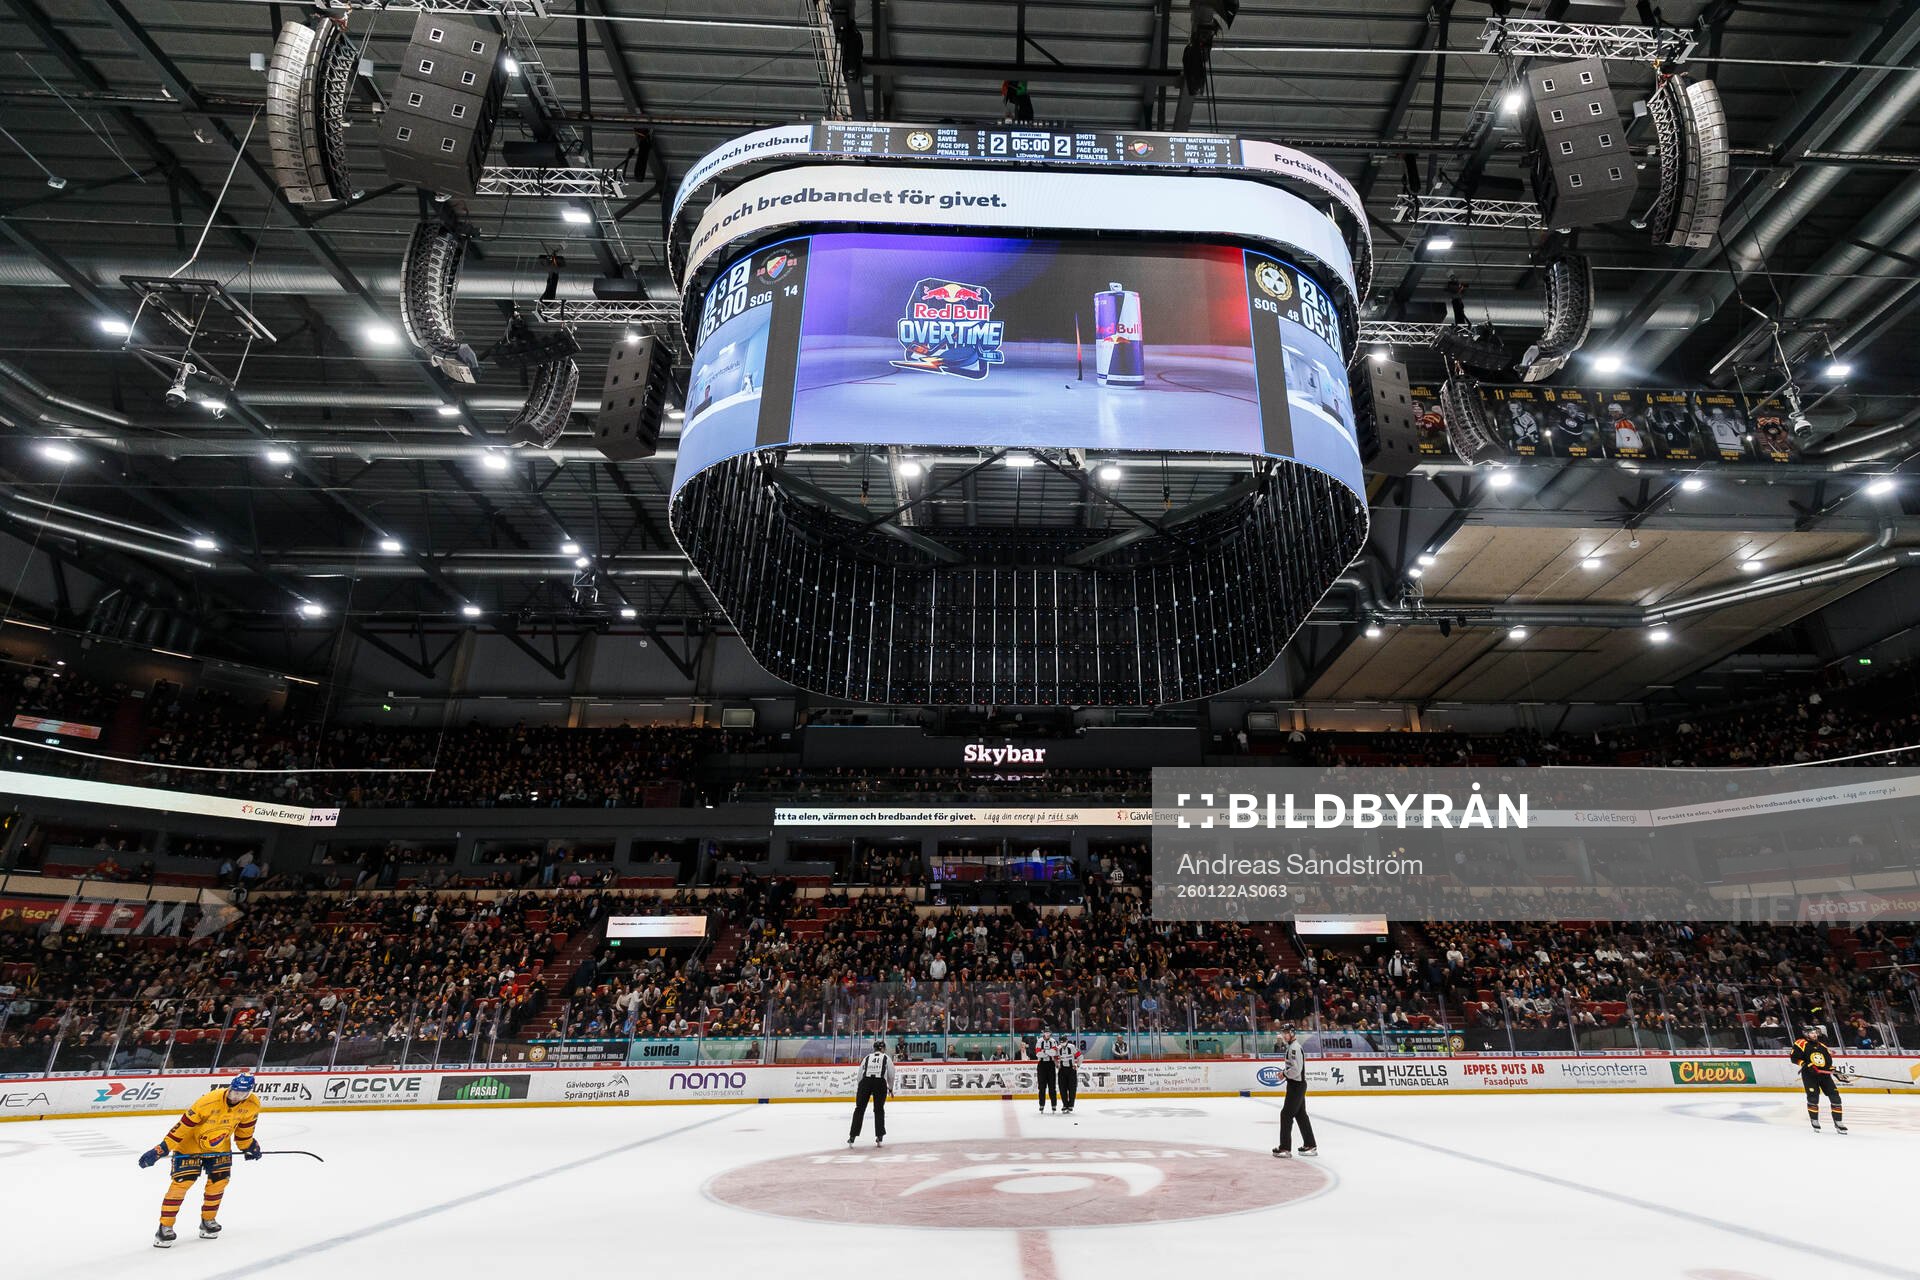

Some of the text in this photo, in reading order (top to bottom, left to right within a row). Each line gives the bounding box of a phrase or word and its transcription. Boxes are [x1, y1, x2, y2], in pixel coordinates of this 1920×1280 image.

[722, 134, 810, 160] och bredband
[994, 137, 1004, 151] 2
[1012, 139, 1050, 151] 05:00
[1057, 139, 1068, 153] 2
[1274, 154, 1334, 184] Fortsätt ta
[721, 188, 1006, 227] och bredbandet för givet.
[733, 266, 745, 285] 2
[750, 285, 798, 307] SOG 14
[1303, 282, 1314, 304] 2
[700, 286, 748, 348] 05:00
[914, 303, 989, 320] Red Bull
[1254, 298, 1300, 322] SOG 48
[900, 320, 1001, 345] OVERTIME
[1117, 324, 1139, 334] Bull
[1494, 390, 1504, 400] 11
[964, 744, 1046, 766] Skybar
[254, 807, 305, 821] Gävle Energi
[1130, 811, 1152, 821] Gävle
[1346, 812, 1396, 821] brdbadet
[1657, 812, 1685, 820] Fortsätt
[1713, 806, 1741, 814] värmen
[1756, 799, 1801, 809] bredbandet
[798, 813, 821, 822] elen,
[823, 812, 858, 821] värmen
[860, 812, 876, 821] och
[878, 812, 932, 821] bredbandet
[934, 812, 948, 821] för
[950, 813, 976, 822] givet.
[983, 812, 1000, 823] Lägg
[1014, 813, 1036, 823] energi
[1037, 812, 1045, 823] på
[1048, 812, 1064, 821] rätt
[1587, 813, 1637, 824] Gävle Energi
[0, 906, 60, 920] piser!
[1808, 900, 1868, 916] STÖRST
[1870, 899, 1890, 914] på
[1320, 1036, 1352, 1048] unda
[643, 1044, 680, 1057] sunda
[1387, 1065, 1447, 1077] HUZELLS
[1463, 1063, 1544, 1075] JEPPES PUTS AB
[1561, 1062, 1648, 1076] Horisonterra
[1679, 1062, 1746, 1082] Cheers
[283, 1083, 299, 1093] AB
[352, 1077, 422, 1092] CCVE
[566, 1081, 605, 1089] Gävleborgs
[669, 1072, 746, 1090] nomo
[901, 1073, 1110, 1089] EN BRA SRT
[1421, 1078, 1449, 1086] DELAR
[1484, 1077, 1528, 1088] Fasadputs
[121, 1082, 164, 1101] elis
[470, 1086, 498, 1097] PASAB
[564, 1091, 616, 1100] Sprängtjänst
[808, 1149, 1230, 1164] SVENSKA SPEL
